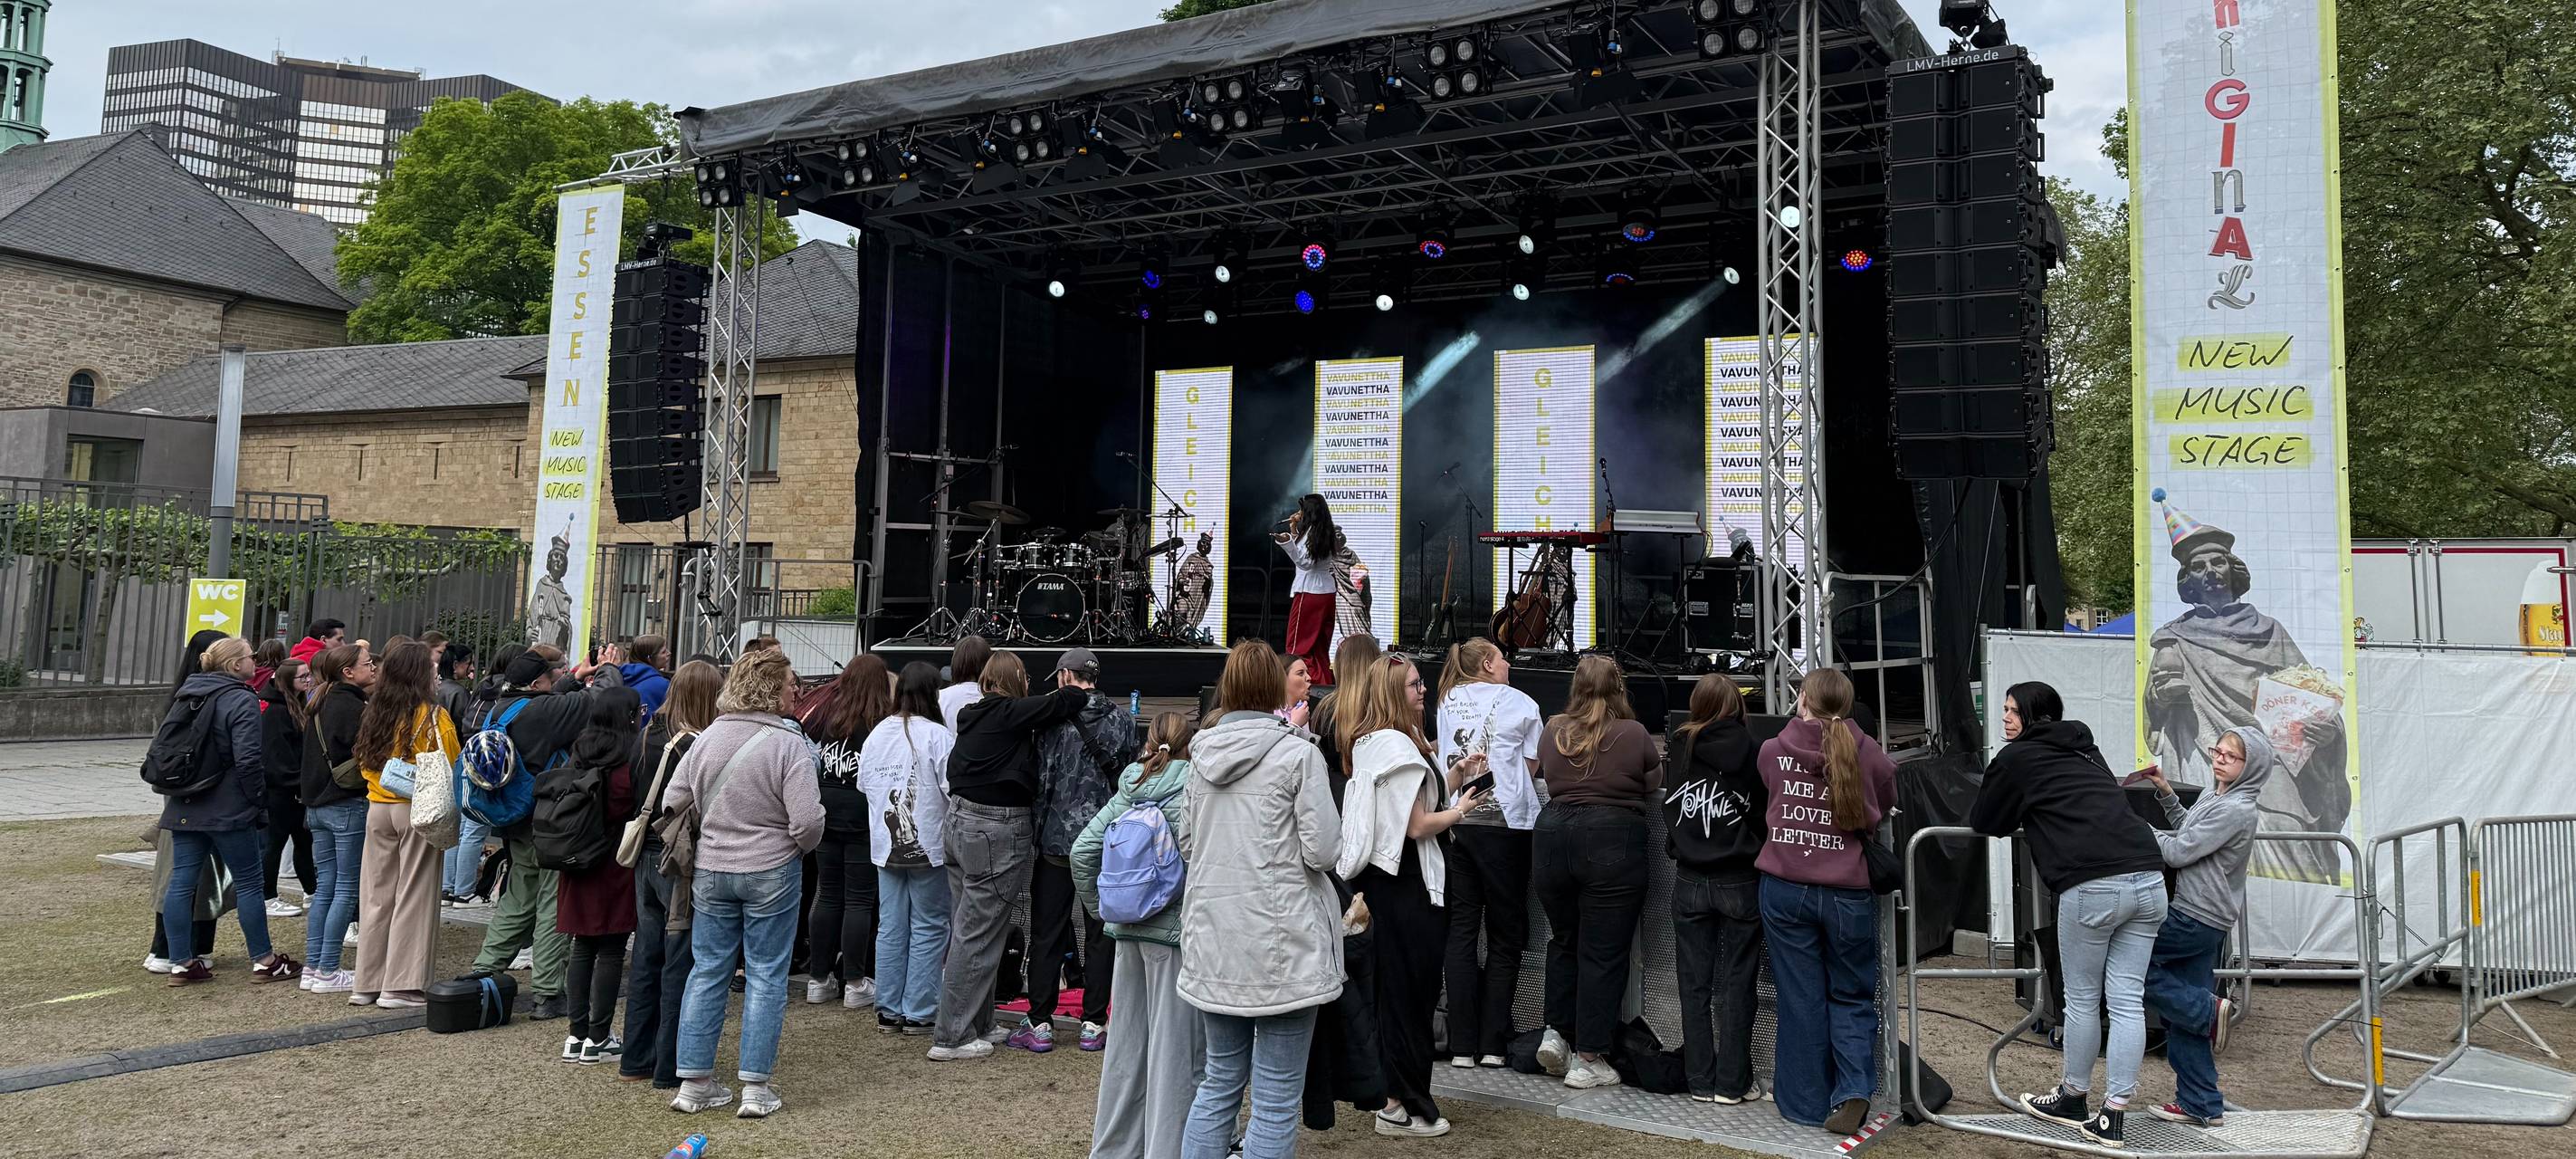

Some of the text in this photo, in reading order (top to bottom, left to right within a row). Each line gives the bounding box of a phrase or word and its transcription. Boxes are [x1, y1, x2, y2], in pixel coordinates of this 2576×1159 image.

[1906, 49, 1999, 72] LMV-Herne.de
[563, 206, 598, 407] ESSEN
[2189, 335, 2294, 369] NEW
[1327, 385, 1390, 396] VAVUNETTHA
[2175, 385, 2306, 420] MUSIC
[1326, 411, 1389, 421] VAVUNETTHA
[552, 429, 585, 446] NEW
[1325, 437, 1388, 447] VAVUNETTHA
[1534, 368, 1551, 532] GLEICH
[2180, 435, 2303, 467] STAGE
[547, 455, 586, 474] MUSIC
[1183, 387, 1199, 532] GLEICH
[1325, 464, 1388, 473] VAVUNETTHA
[545, 482, 582, 500] STAGE
[1324, 490, 1388, 500] VAVUNETTHA
[196, 584, 239, 600] WC
[2261, 694, 2297, 712] DÖNER
[1783, 780, 1814, 798] ME
[1781, 804, 1831, 825] LOVE
[1771, 827, 1845, 850] LETTER
